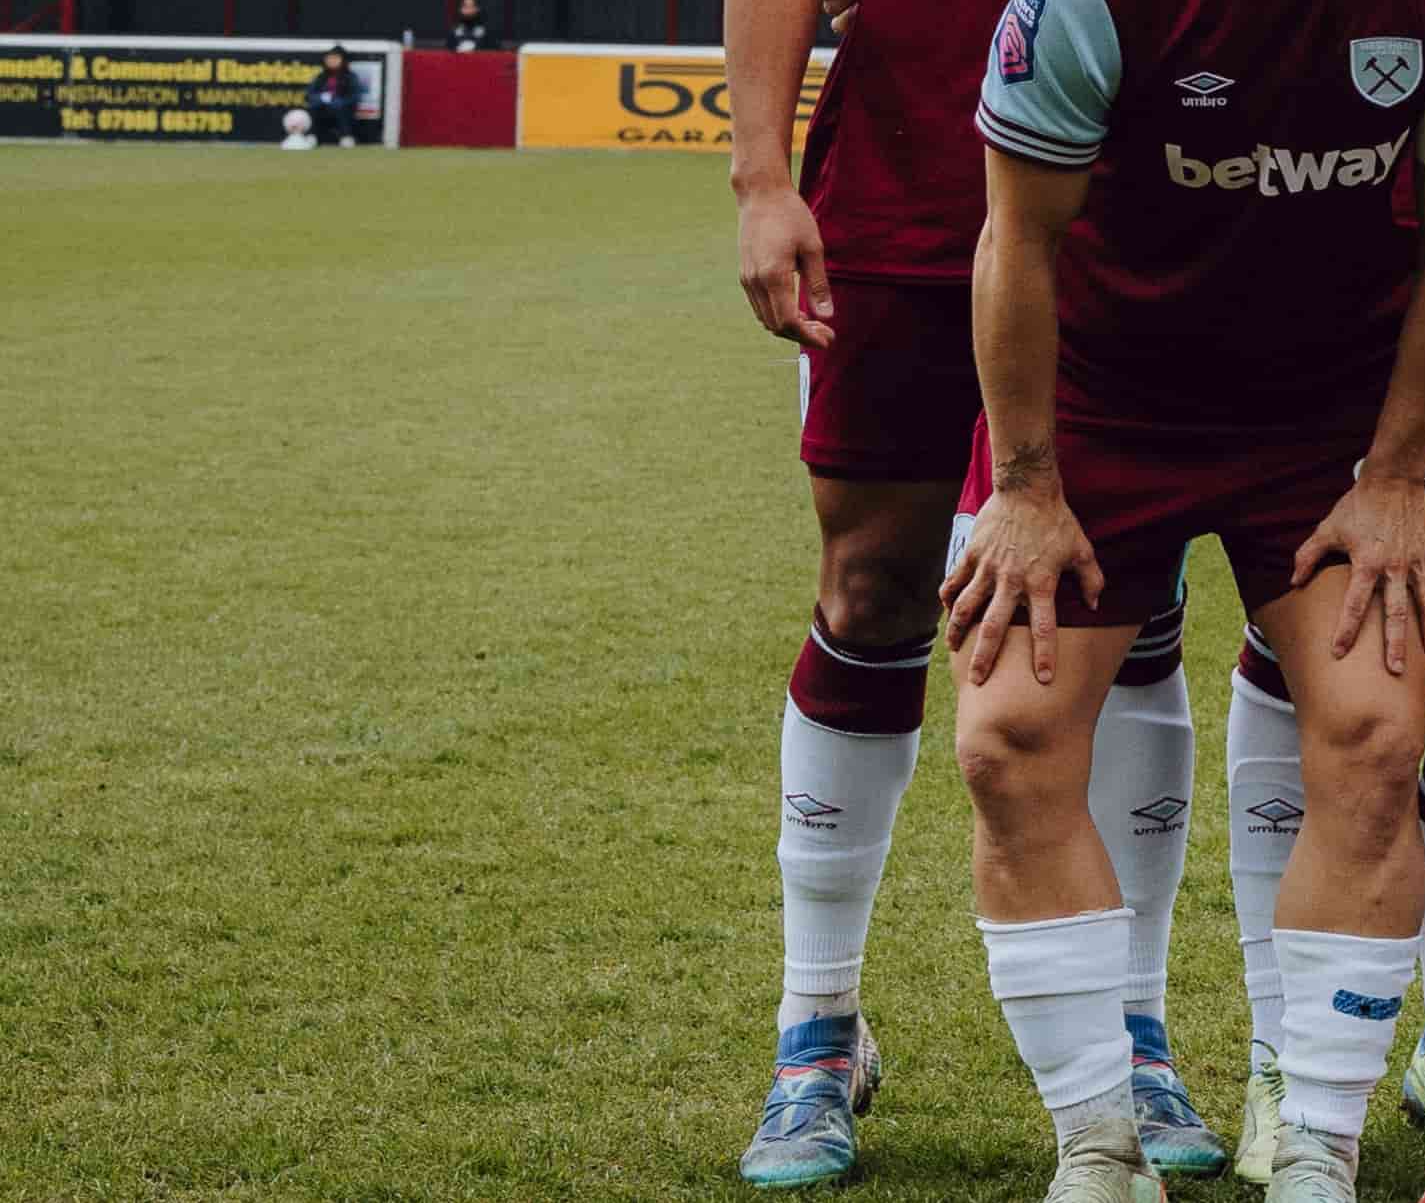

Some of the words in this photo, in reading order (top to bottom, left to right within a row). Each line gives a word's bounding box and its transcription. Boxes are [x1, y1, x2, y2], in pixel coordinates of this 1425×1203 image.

[92, 55, 212, 82] Commercial
[56, 86, 179, 104] INSTALLATION
[1181, 95, 1227, 108] umbro
[62, 108, 94, 130] Tel:
[1165, 127, 1410, 196] betway
[785, 812, 838, 830] umbro
[1133, 821, 1185, 836] umbro
